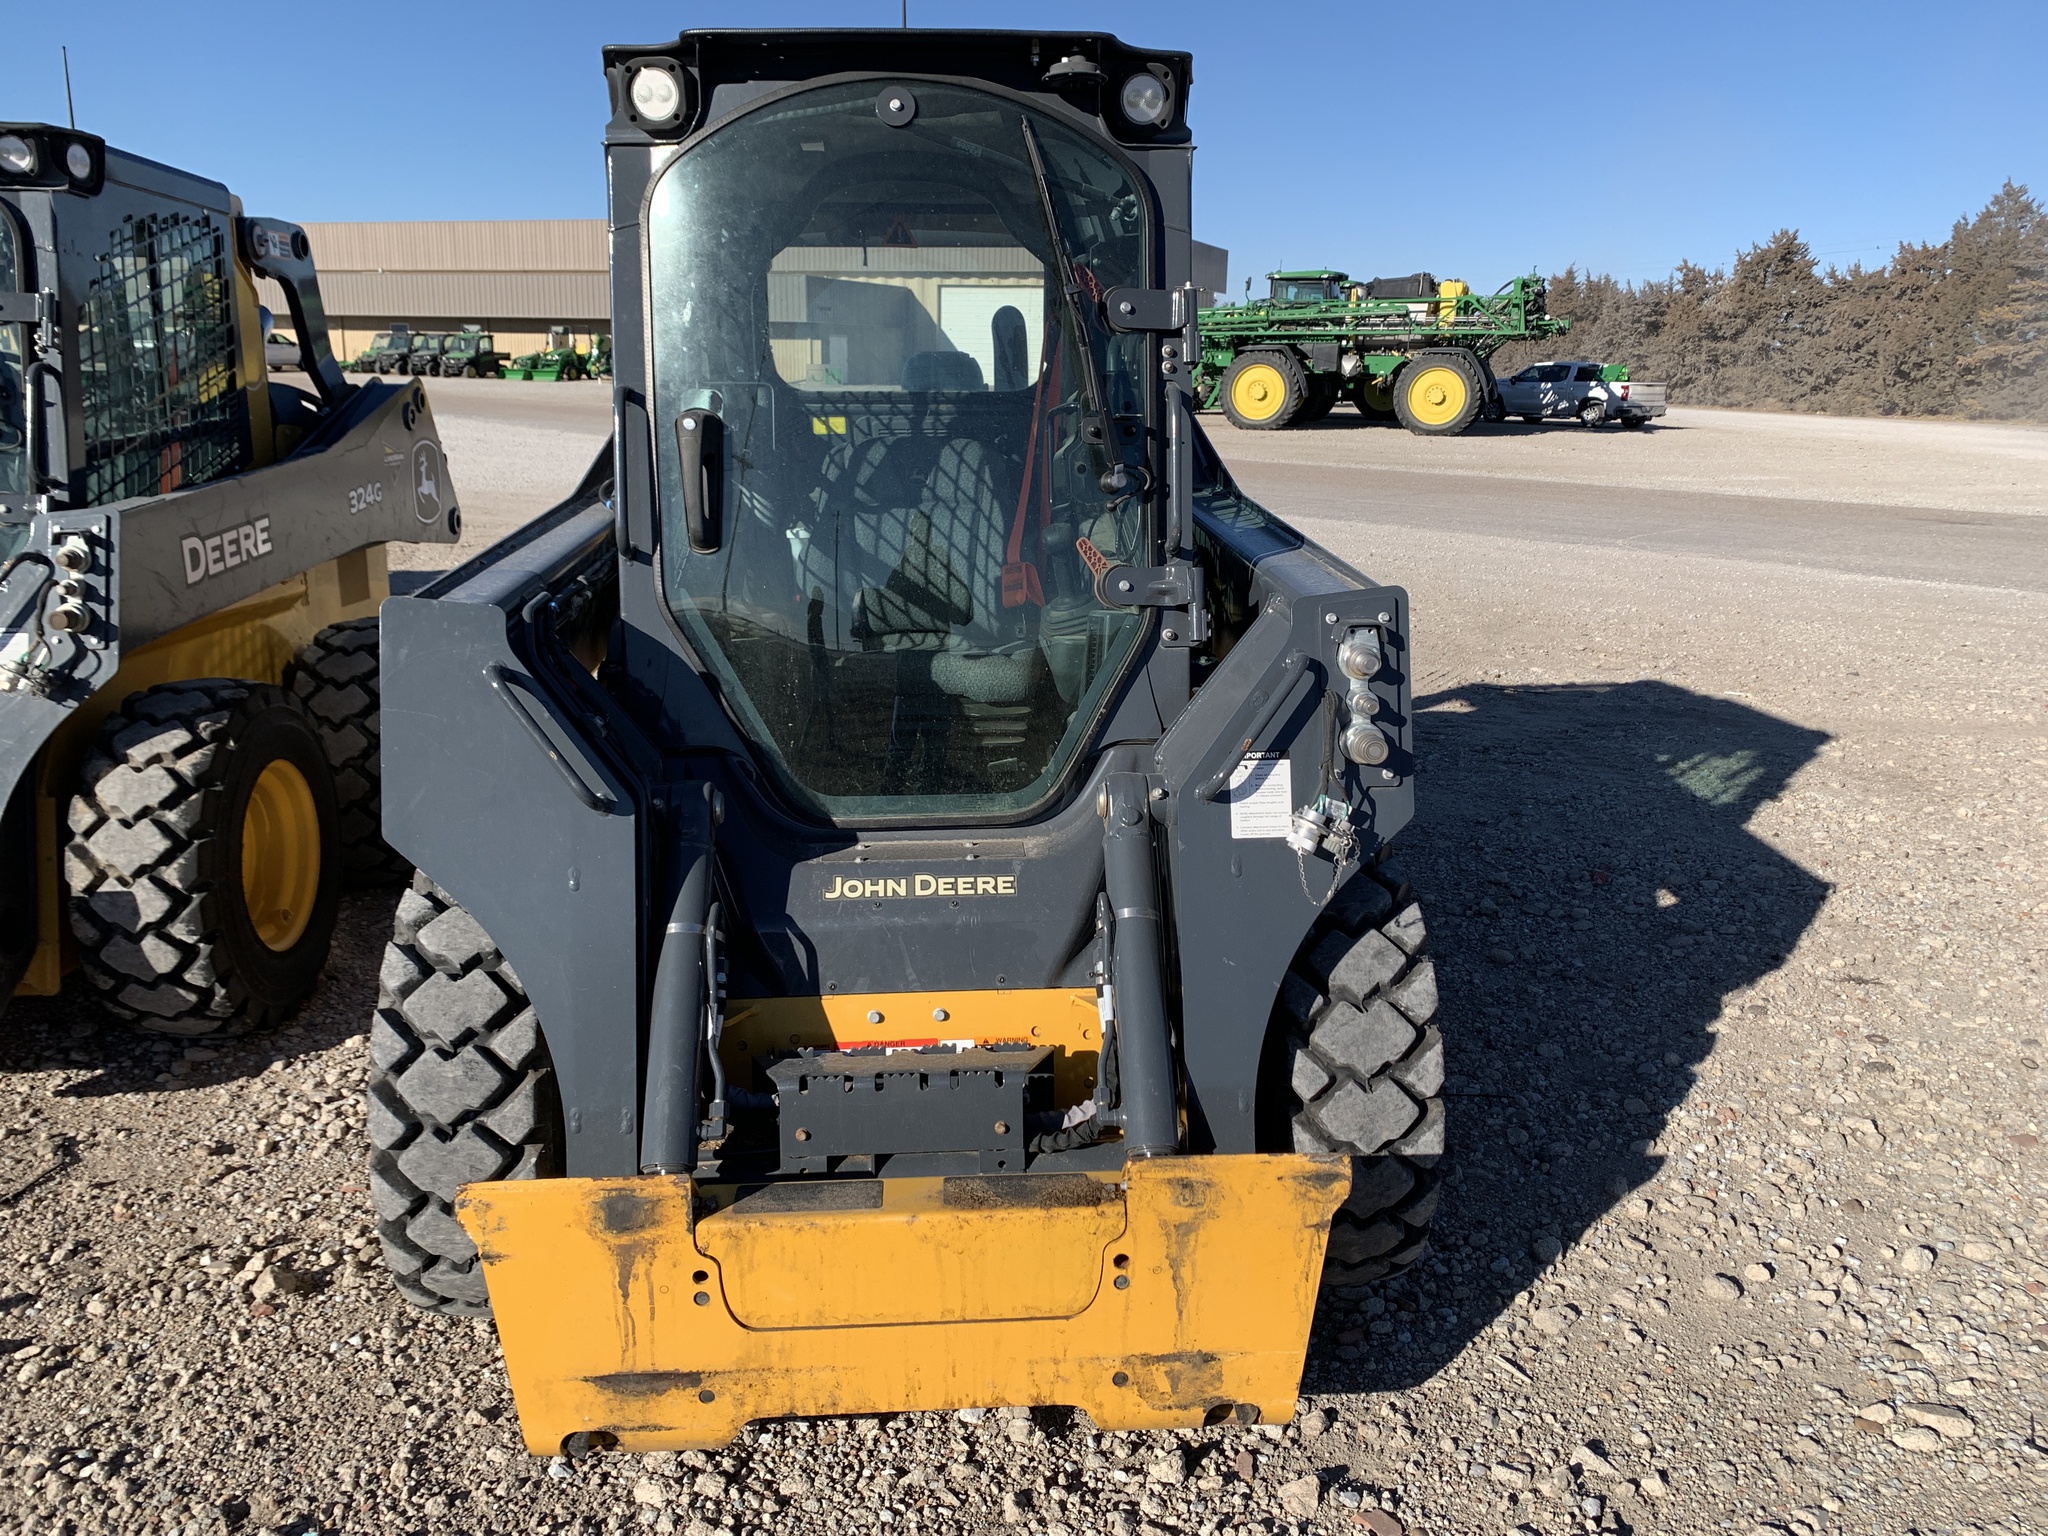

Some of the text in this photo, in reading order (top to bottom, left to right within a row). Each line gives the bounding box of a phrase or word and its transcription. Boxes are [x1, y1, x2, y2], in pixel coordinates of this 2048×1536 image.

[349, 482, 382, 514] 324G
[181, 517, 273, 585] DEERE
[824, 874, 1016, 899] JOHN DEERE
[873, 1040, 906, 1048] DANGER
[995, 1036, 1028, 1044] WARNING
